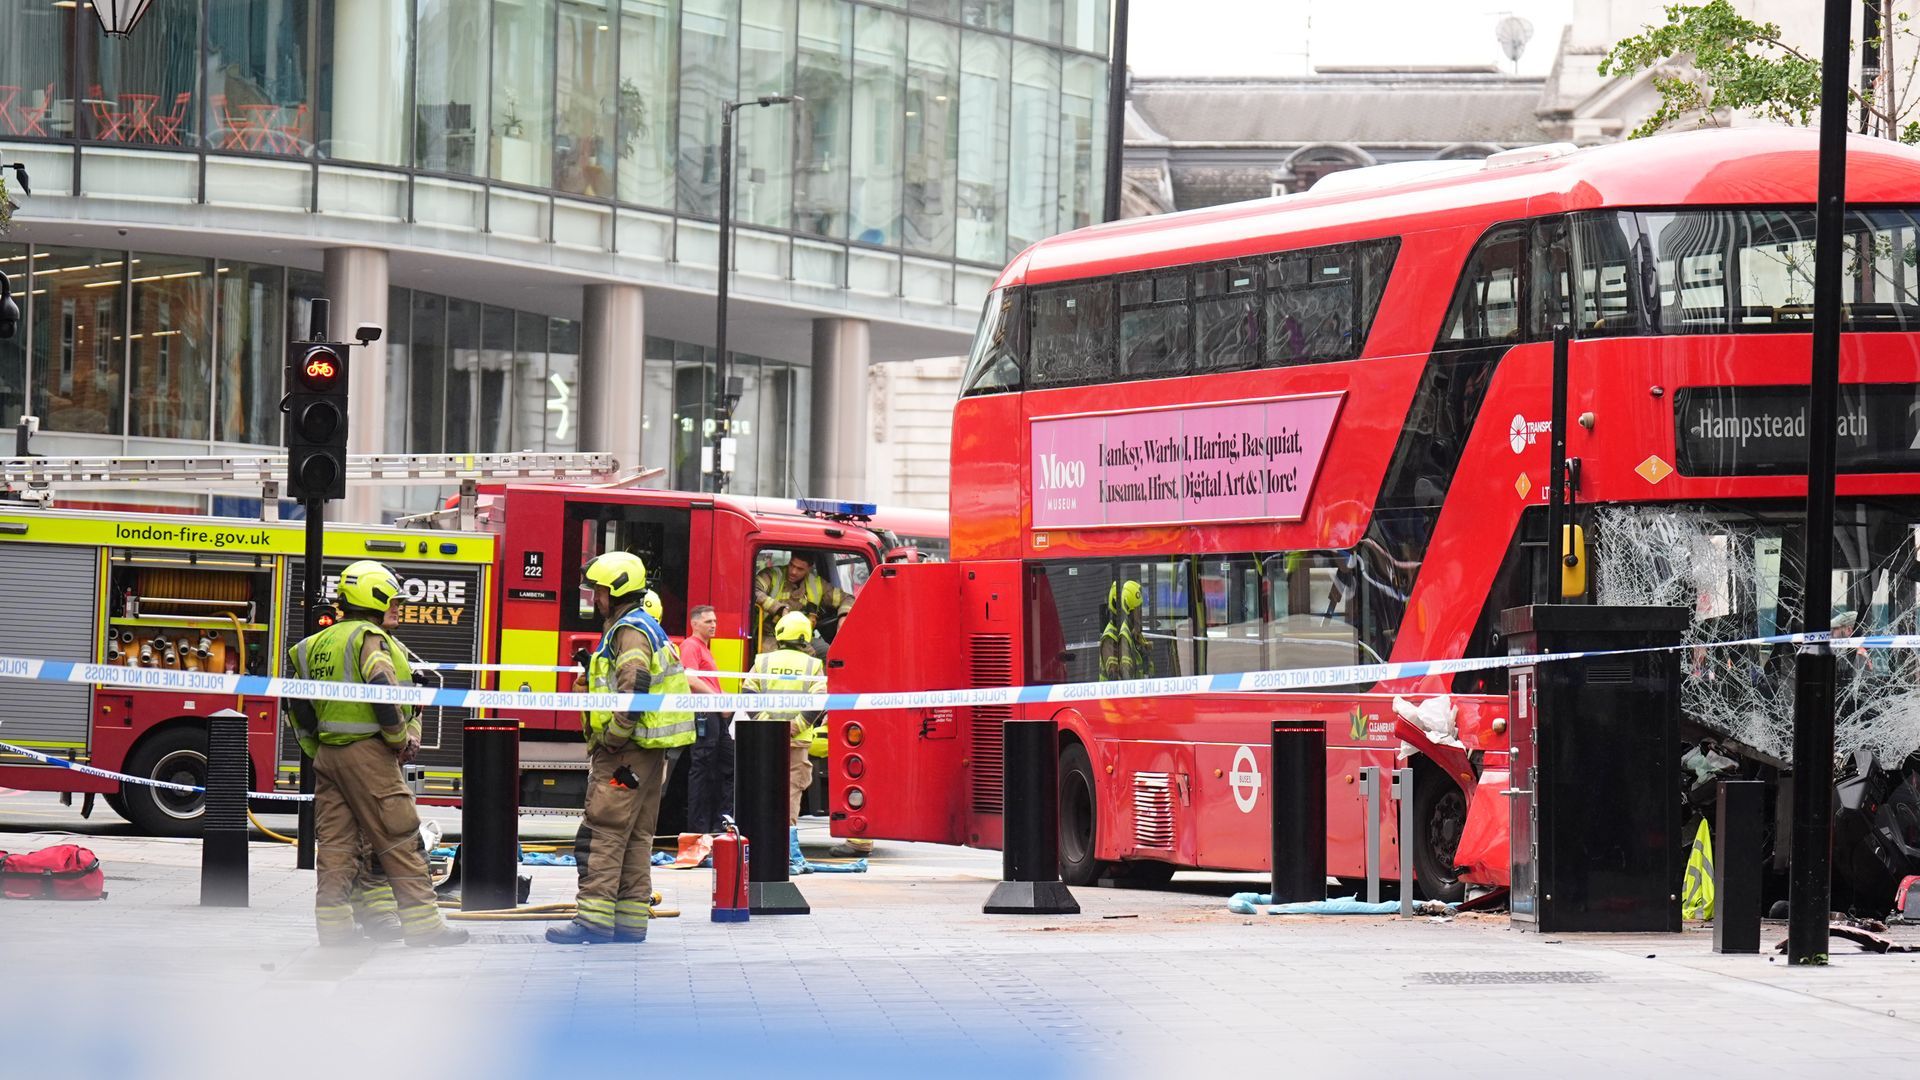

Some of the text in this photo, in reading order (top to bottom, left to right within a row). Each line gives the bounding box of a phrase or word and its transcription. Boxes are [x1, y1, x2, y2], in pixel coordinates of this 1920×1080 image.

[1526, 420, 1552, 432] TRANSPO
[1700, 406, 1806, 447] Hampstead
[1836, 406, 1868, 436] ath
[1144, 435, 1192, 464] Warhol,
[1194, 432, 1240, 464] Haring,
[1242, 426, 1302, 462] Basquiat,
[1527, 434, 1536, 444] UK
[1038, 454, 1085, 490] Moco
[1148, 474, 1179, 502] Hirst,
[1182, 470, 1222, 504] Digital
[1222, 472, 1246, 496] Art
[1246, 470, 1257, 495] &
[1258, 466, 1297, 494] More!
[1048, 497, 1077, 510] MUSEUM
[116, 524, 270, 548] london-fire.gov.uk
[530, 554, 538, 564] H
[524, 566, 542, 576] 222
[402, 578, 466, 604] ORE
[1240, 776, 1252, 784] BUSES
